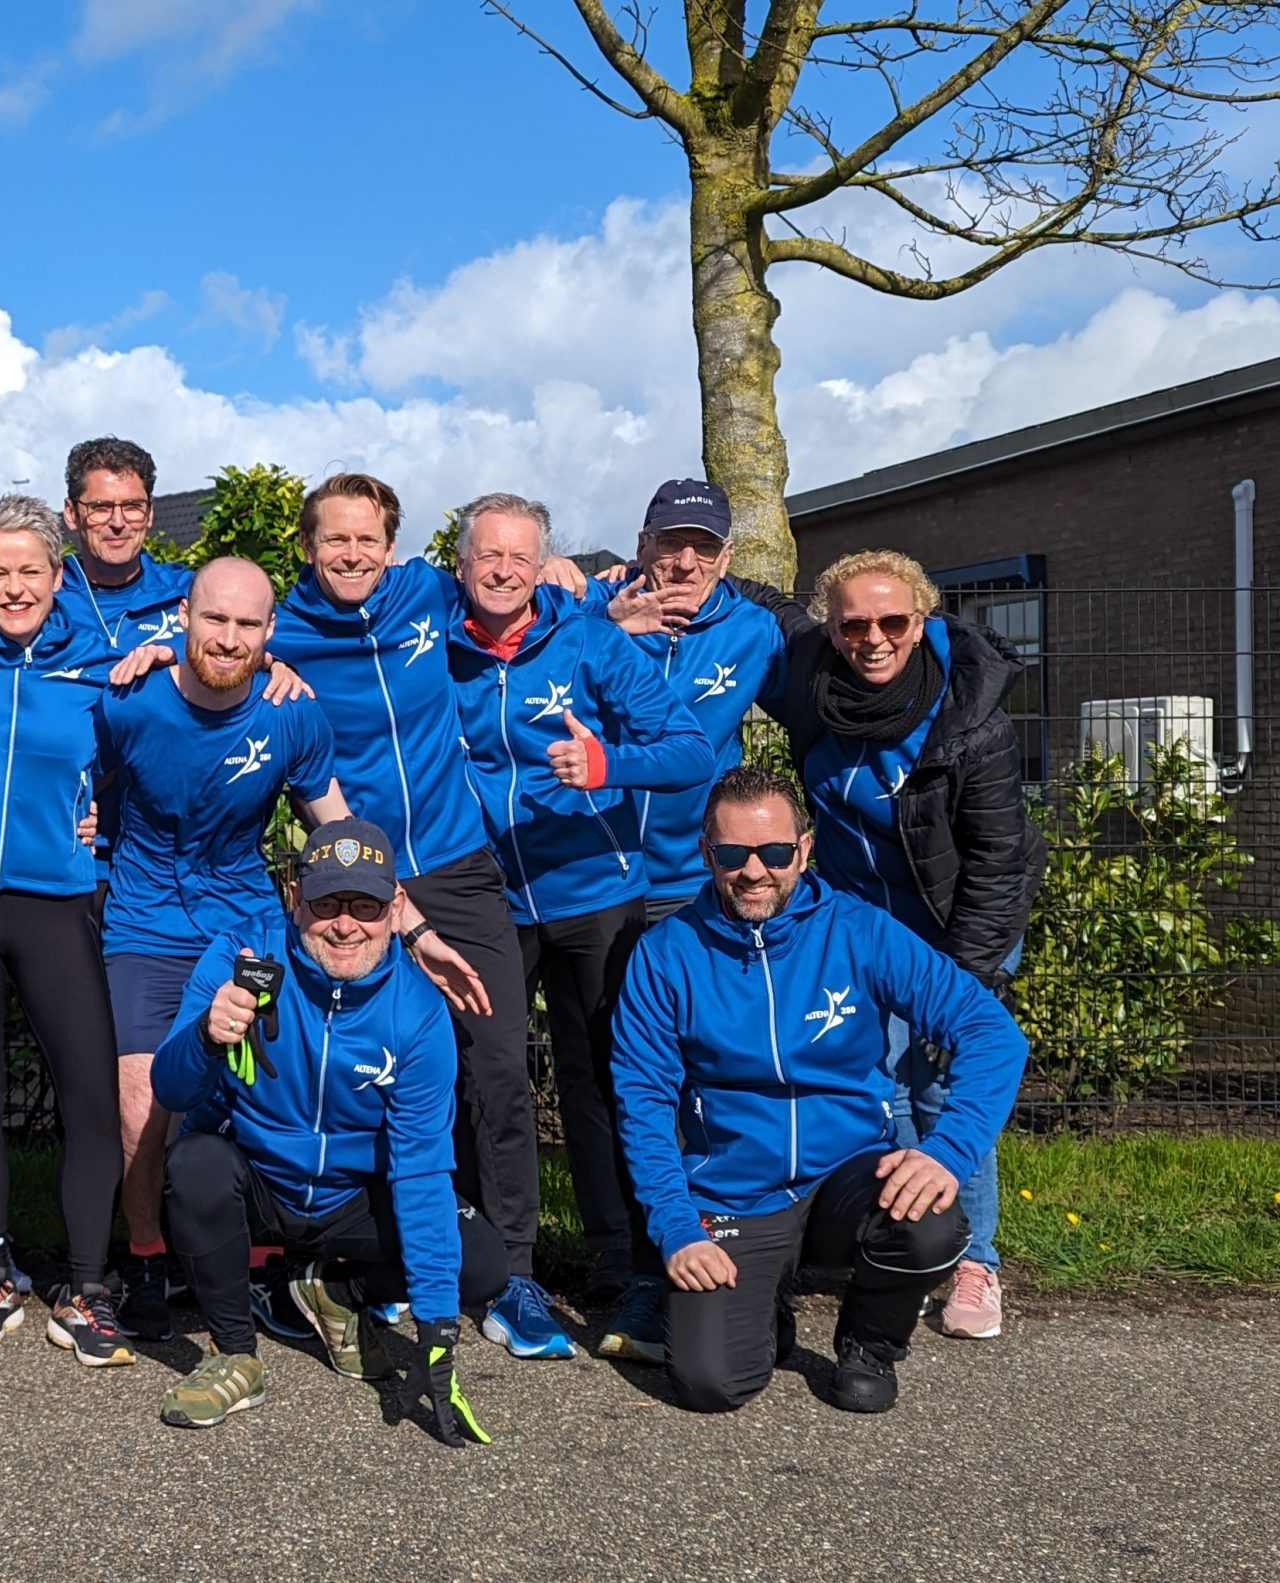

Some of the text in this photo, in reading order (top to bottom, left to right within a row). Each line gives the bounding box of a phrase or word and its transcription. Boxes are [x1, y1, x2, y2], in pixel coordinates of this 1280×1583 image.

[137, 623, 160, 631] ALTENA
[397, 637, 419, 650] ALTENA
[693, 677, 715, 685] ALTENA
[524, 697, 549, 705] ALTENA
[223, 755, 248, 765] ALTENA
[804, 1009, 829, 1022] ALTENA
[353, 1063, 381, 1075] ALTENA
